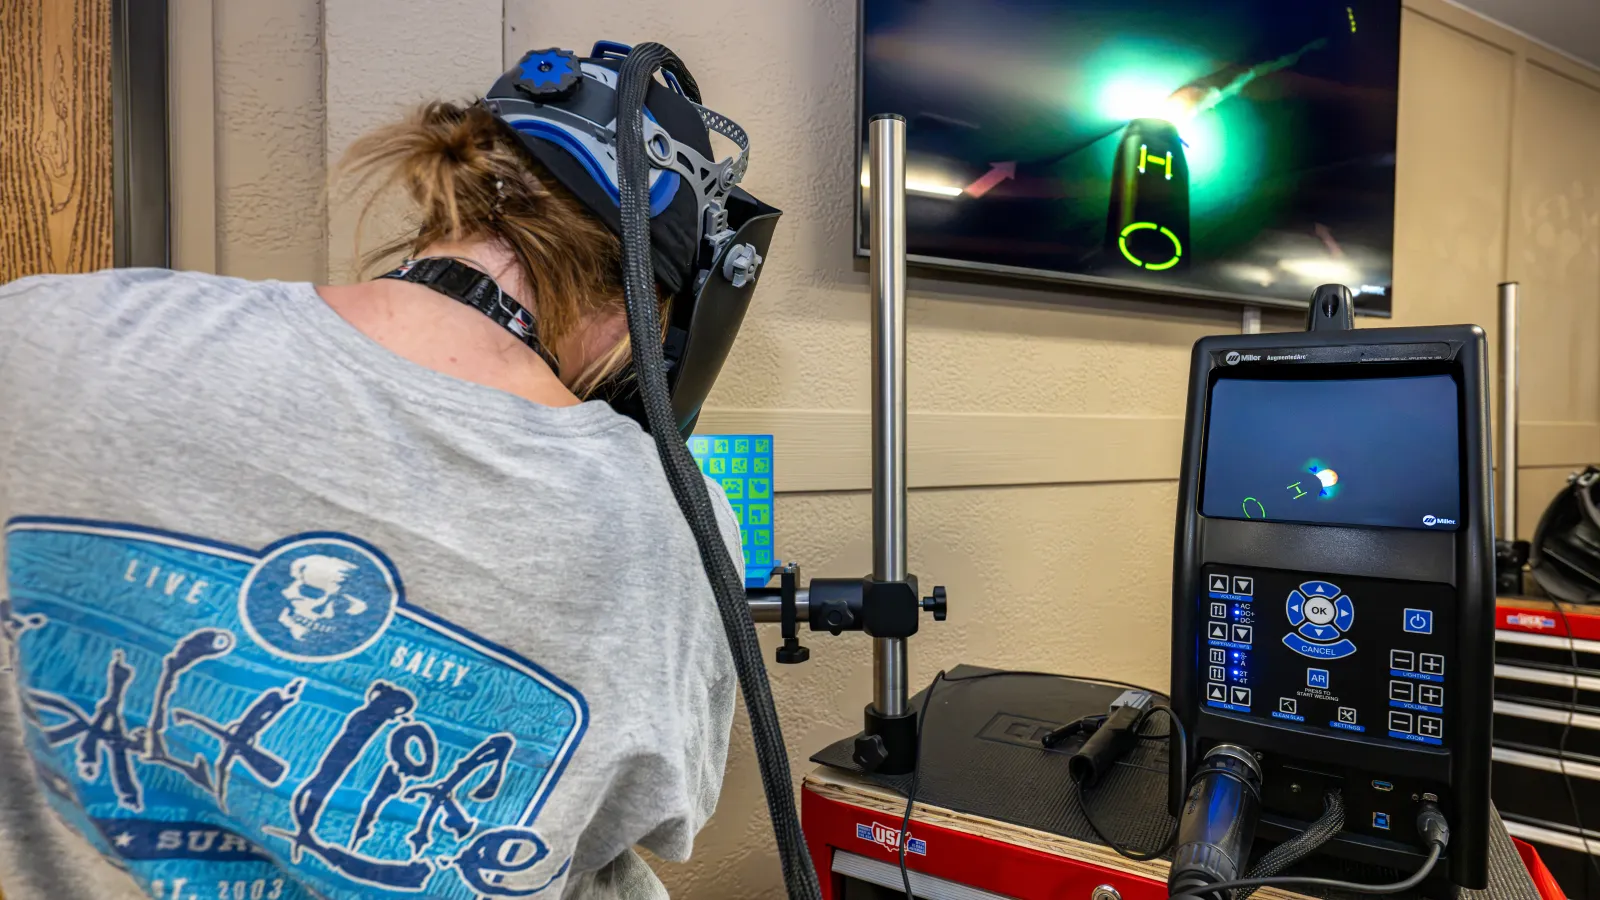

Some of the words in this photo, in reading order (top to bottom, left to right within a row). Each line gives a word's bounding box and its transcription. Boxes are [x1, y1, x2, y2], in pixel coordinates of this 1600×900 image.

[1241, 354, 1261, 362] Miller
[1311, 606, 1327, 616] OK
[124, 559, 208, 604] LIVE
[390, 646, 470, 686] SALTY
[1301, 645, 1336, 656] CANCEL
[1311, 674, 1325, 683] AR
[1402, 671, 1430, 679] LIGHTING
[1304, 687, 1322, 695] PRESS
[1314, 694, 1339, 702] WELDING
[1403, 702, 1429, 711] VOLUME
[1272, 711, 1289, 719] CLEAN
[1333, 721, 1361, 731] SETTINGS
[156, 830, 264, 853] SUR
[217, 879, 285, 900] 2003
